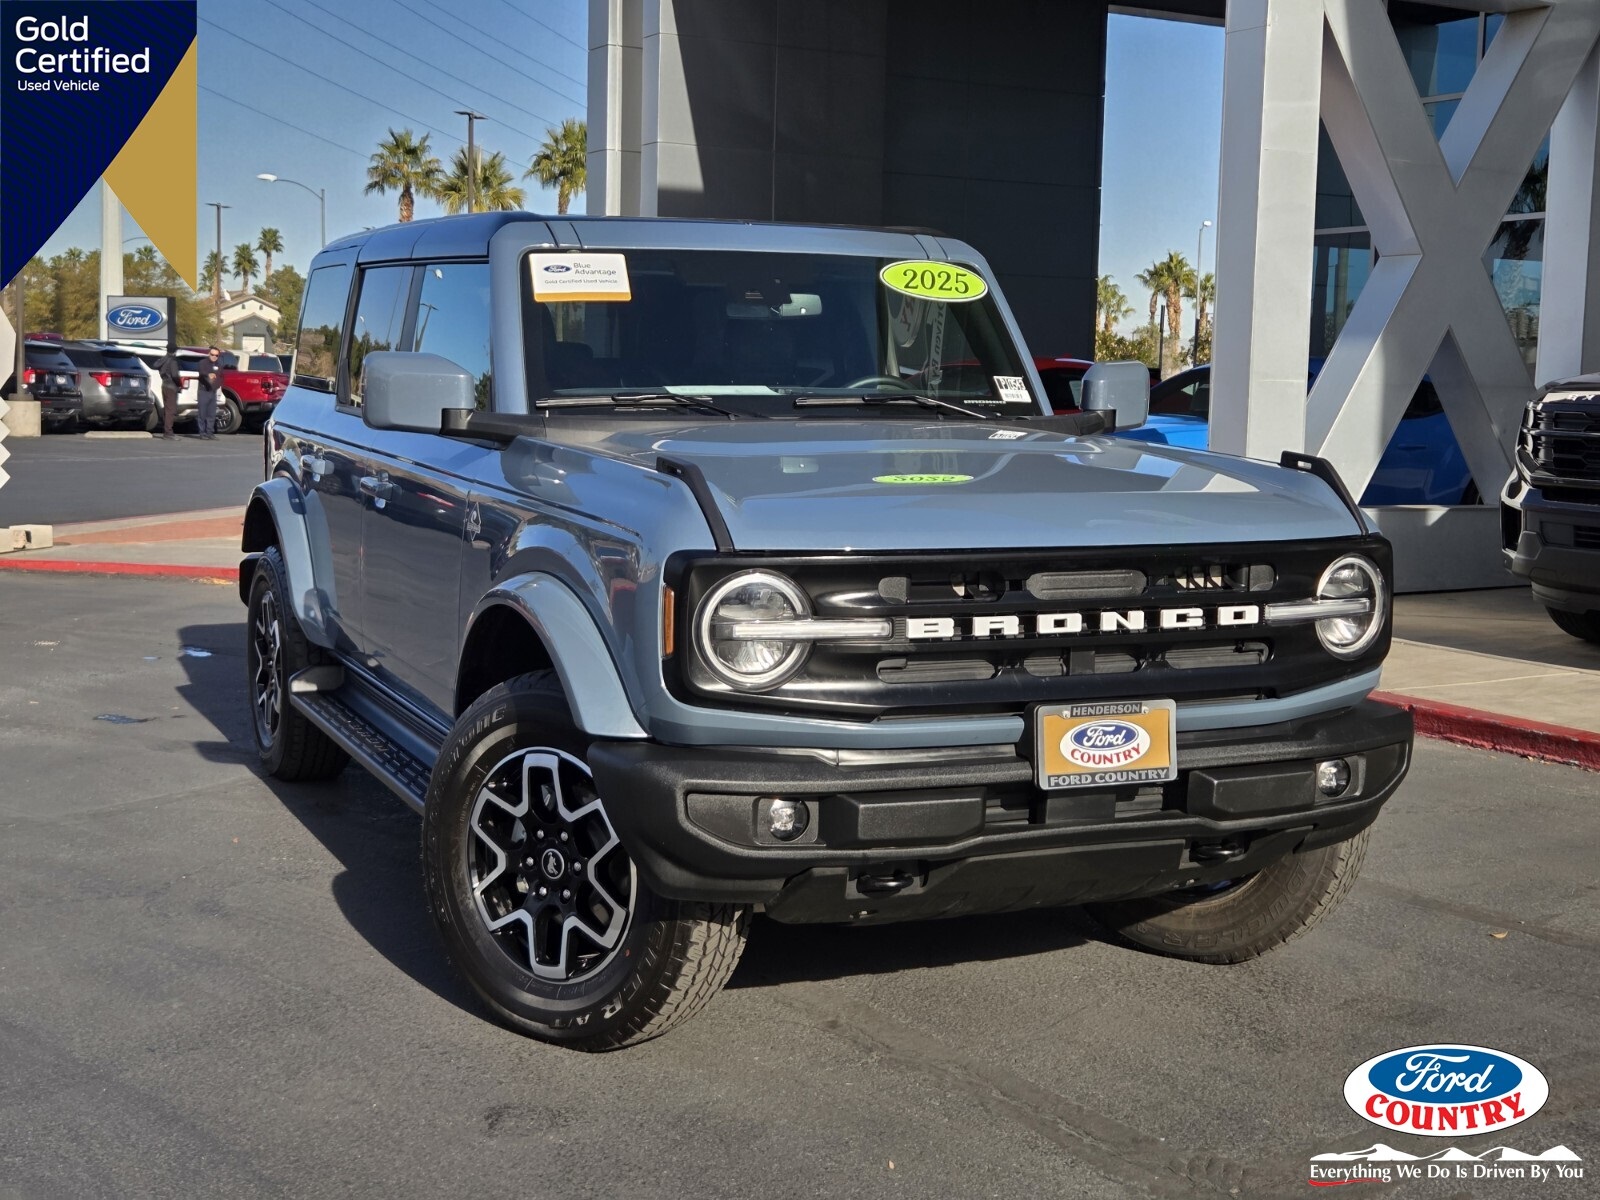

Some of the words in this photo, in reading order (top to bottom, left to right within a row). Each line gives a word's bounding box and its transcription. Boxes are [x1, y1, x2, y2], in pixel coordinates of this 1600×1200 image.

[902, 268, 970, 294] 2025
[117, 308, 152, 326] Ford
[906, 605, 1259, 639] BRONCO
[1072, 703, 1141, 717] HENDERSON
[1082, 726, 1127, 747] Ford
[1070, 743, 1142, 765] COUNTRY
[1050, 774, 1092, 787] FORD
[1094, 768, 1168, 784] COUNTRY
